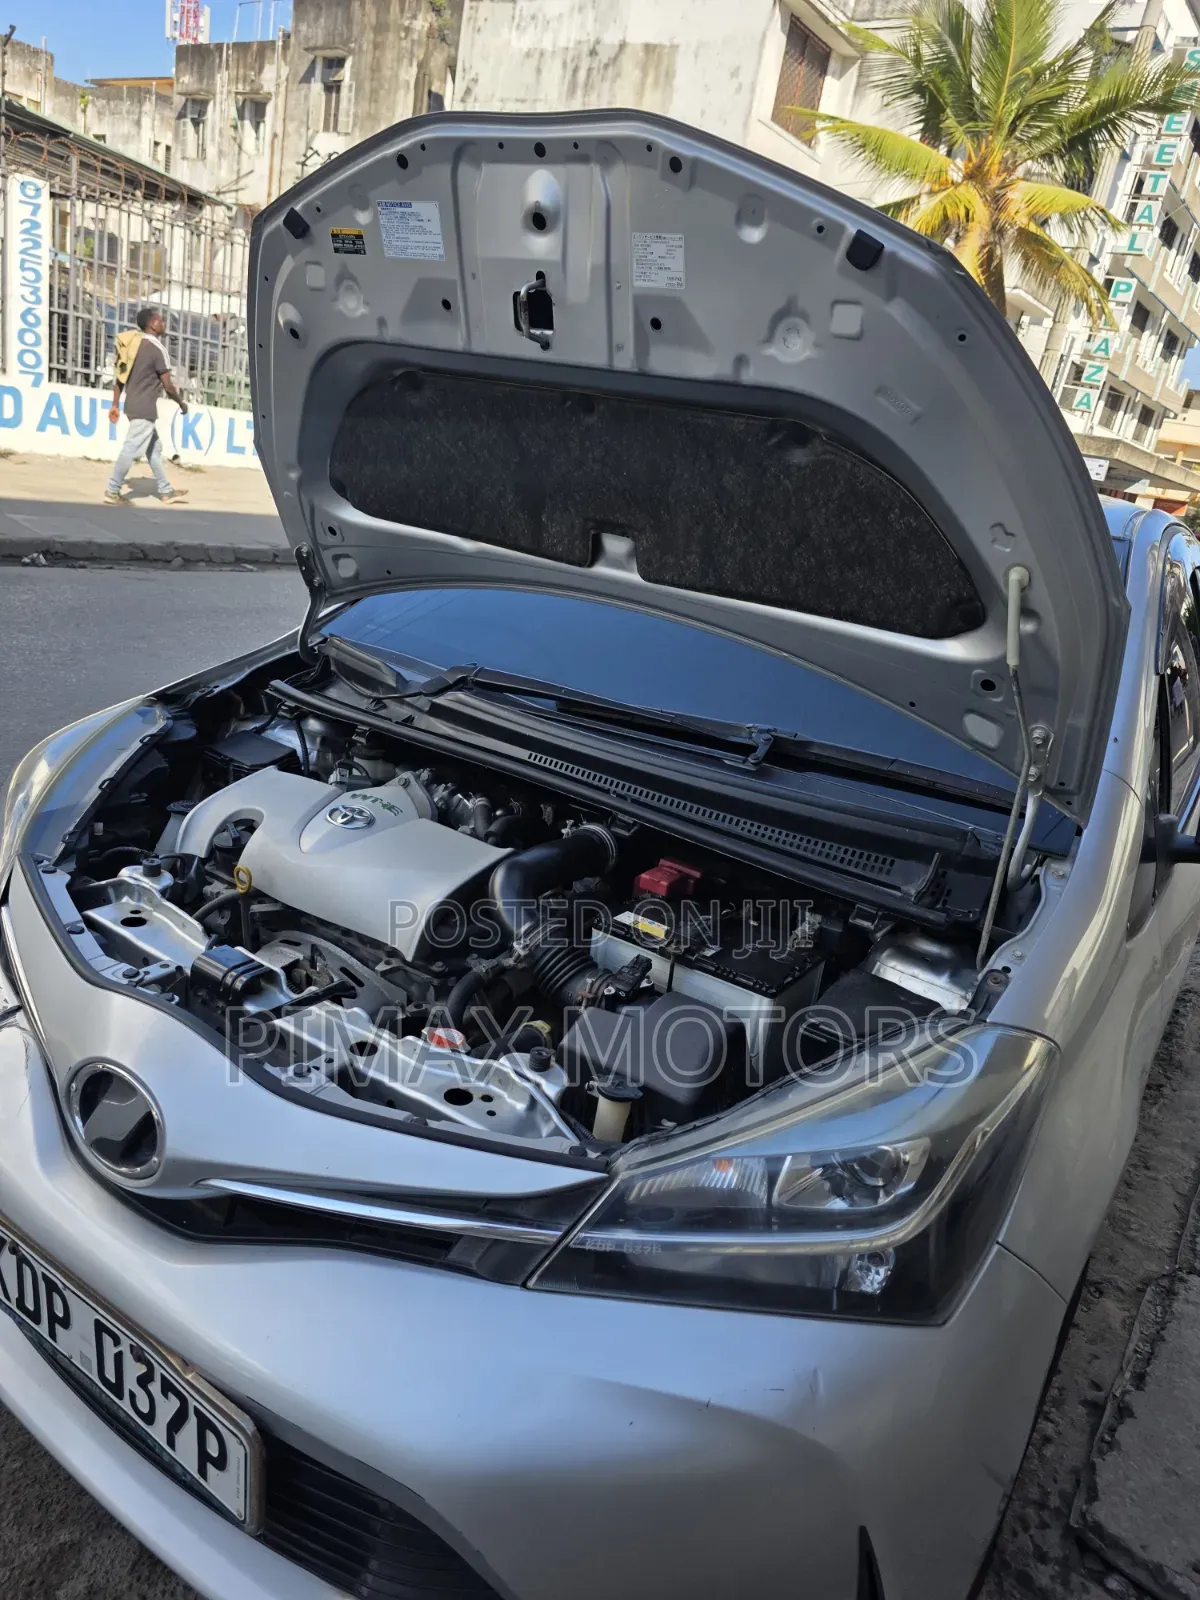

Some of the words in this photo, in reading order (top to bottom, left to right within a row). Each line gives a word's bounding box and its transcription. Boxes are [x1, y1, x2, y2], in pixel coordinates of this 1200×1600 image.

[18, 181, 43, 387] 0722536007
[1075, 281, 1133, 410] PAZA
[36, 392, 125, 440] AUT
[171, 407, 215, 456] (K)
[94, 1317, 228, 1483] 037P
